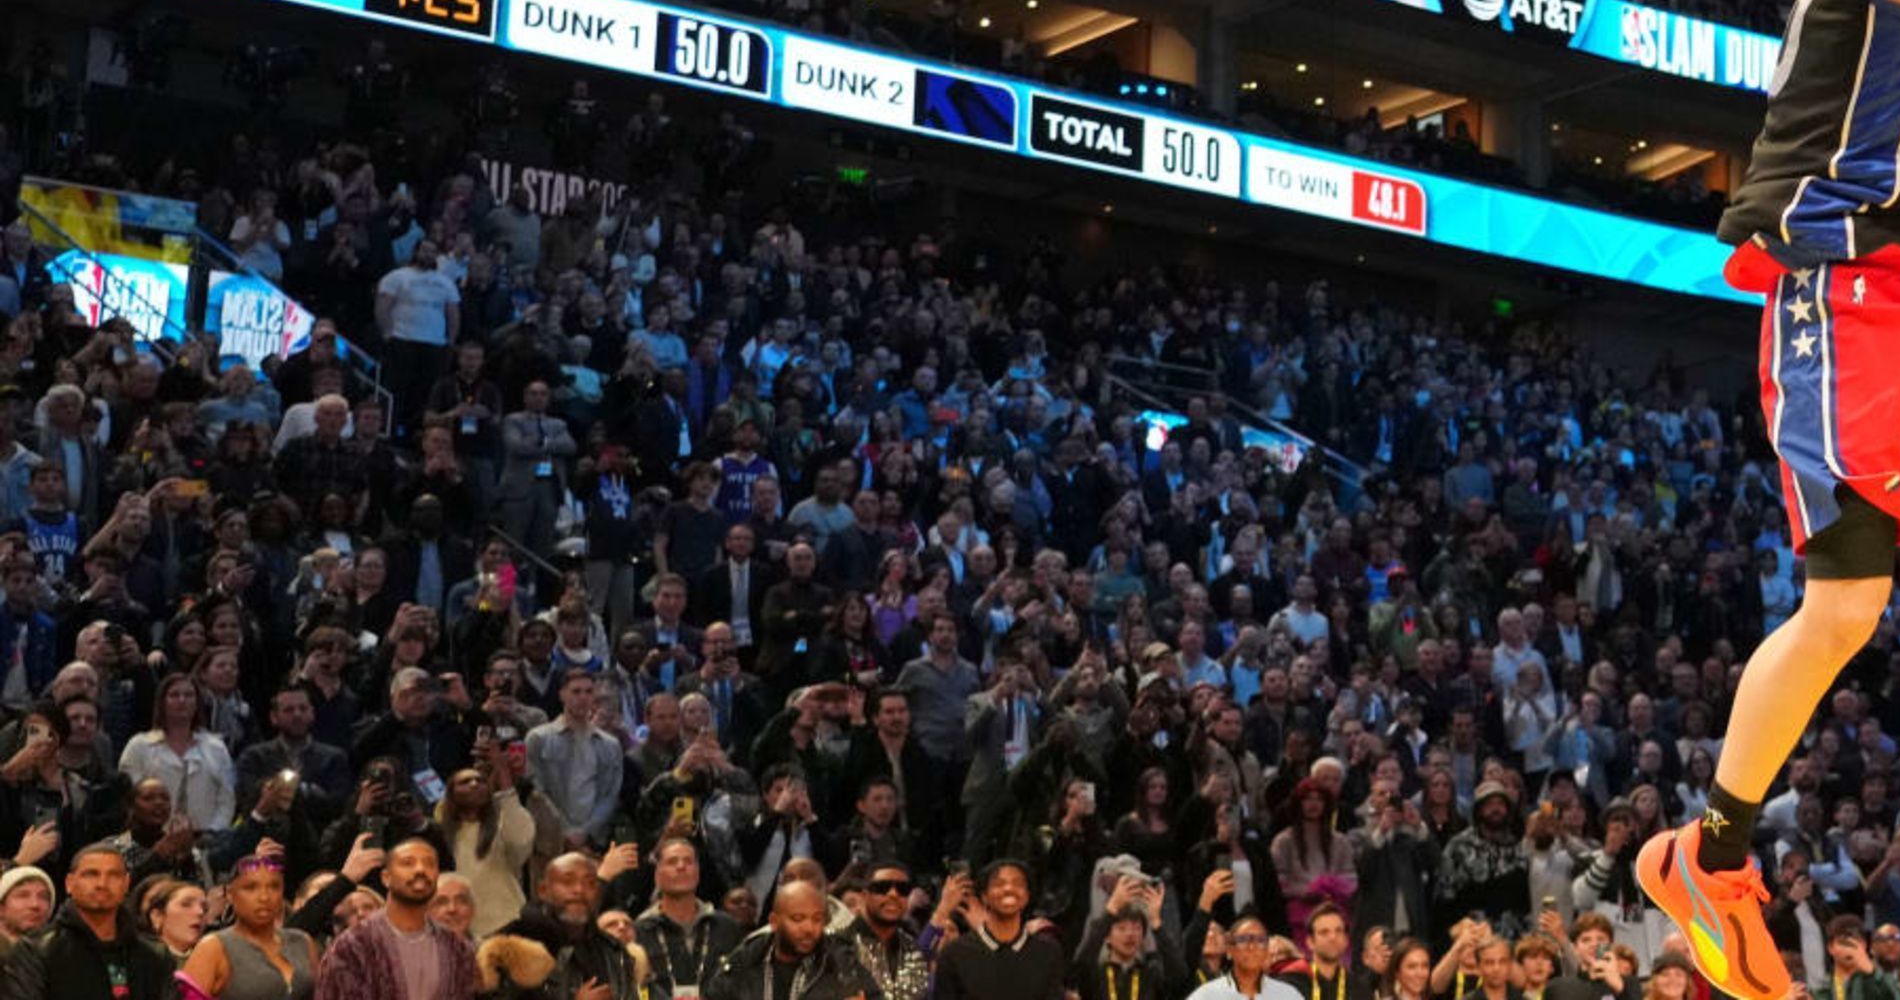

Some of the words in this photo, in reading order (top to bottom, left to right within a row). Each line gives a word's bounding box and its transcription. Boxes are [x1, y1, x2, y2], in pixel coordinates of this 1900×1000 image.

[523, 0, 616, 45] DUNK
[629, 25, 643, 49] 1
[1641, 6, 1716, 83] SLAM
[674, 19, 752, 85] 50.0
[795, 60, 878, 100] DUNK
[888, 81, 904, 105] 2
[1043, 112, 1132, 156] TOTAL
[1161, 127, 1221, 183] 50.0
[1265, 165, 1293, 190] TO
[1298, 174, 1339, 199] WIN
[1367, 179, 1408, 222] 48.1
